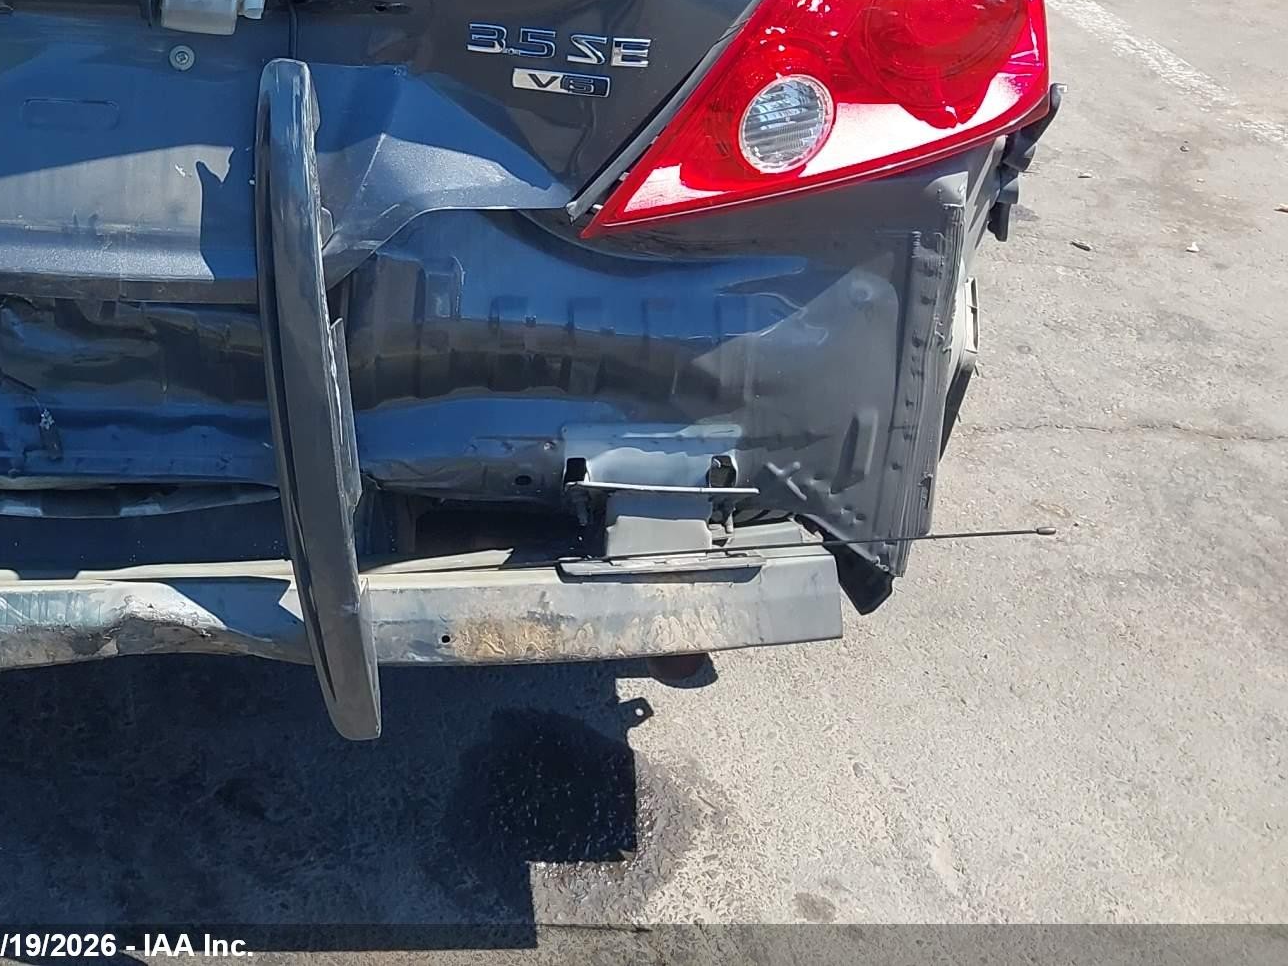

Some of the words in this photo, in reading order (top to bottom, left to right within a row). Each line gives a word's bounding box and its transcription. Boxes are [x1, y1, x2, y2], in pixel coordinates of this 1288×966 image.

[466, 23, 556, 59] 3.5
[566, 34, 652, 68] SE
[527, 73, 595, 94] V6
